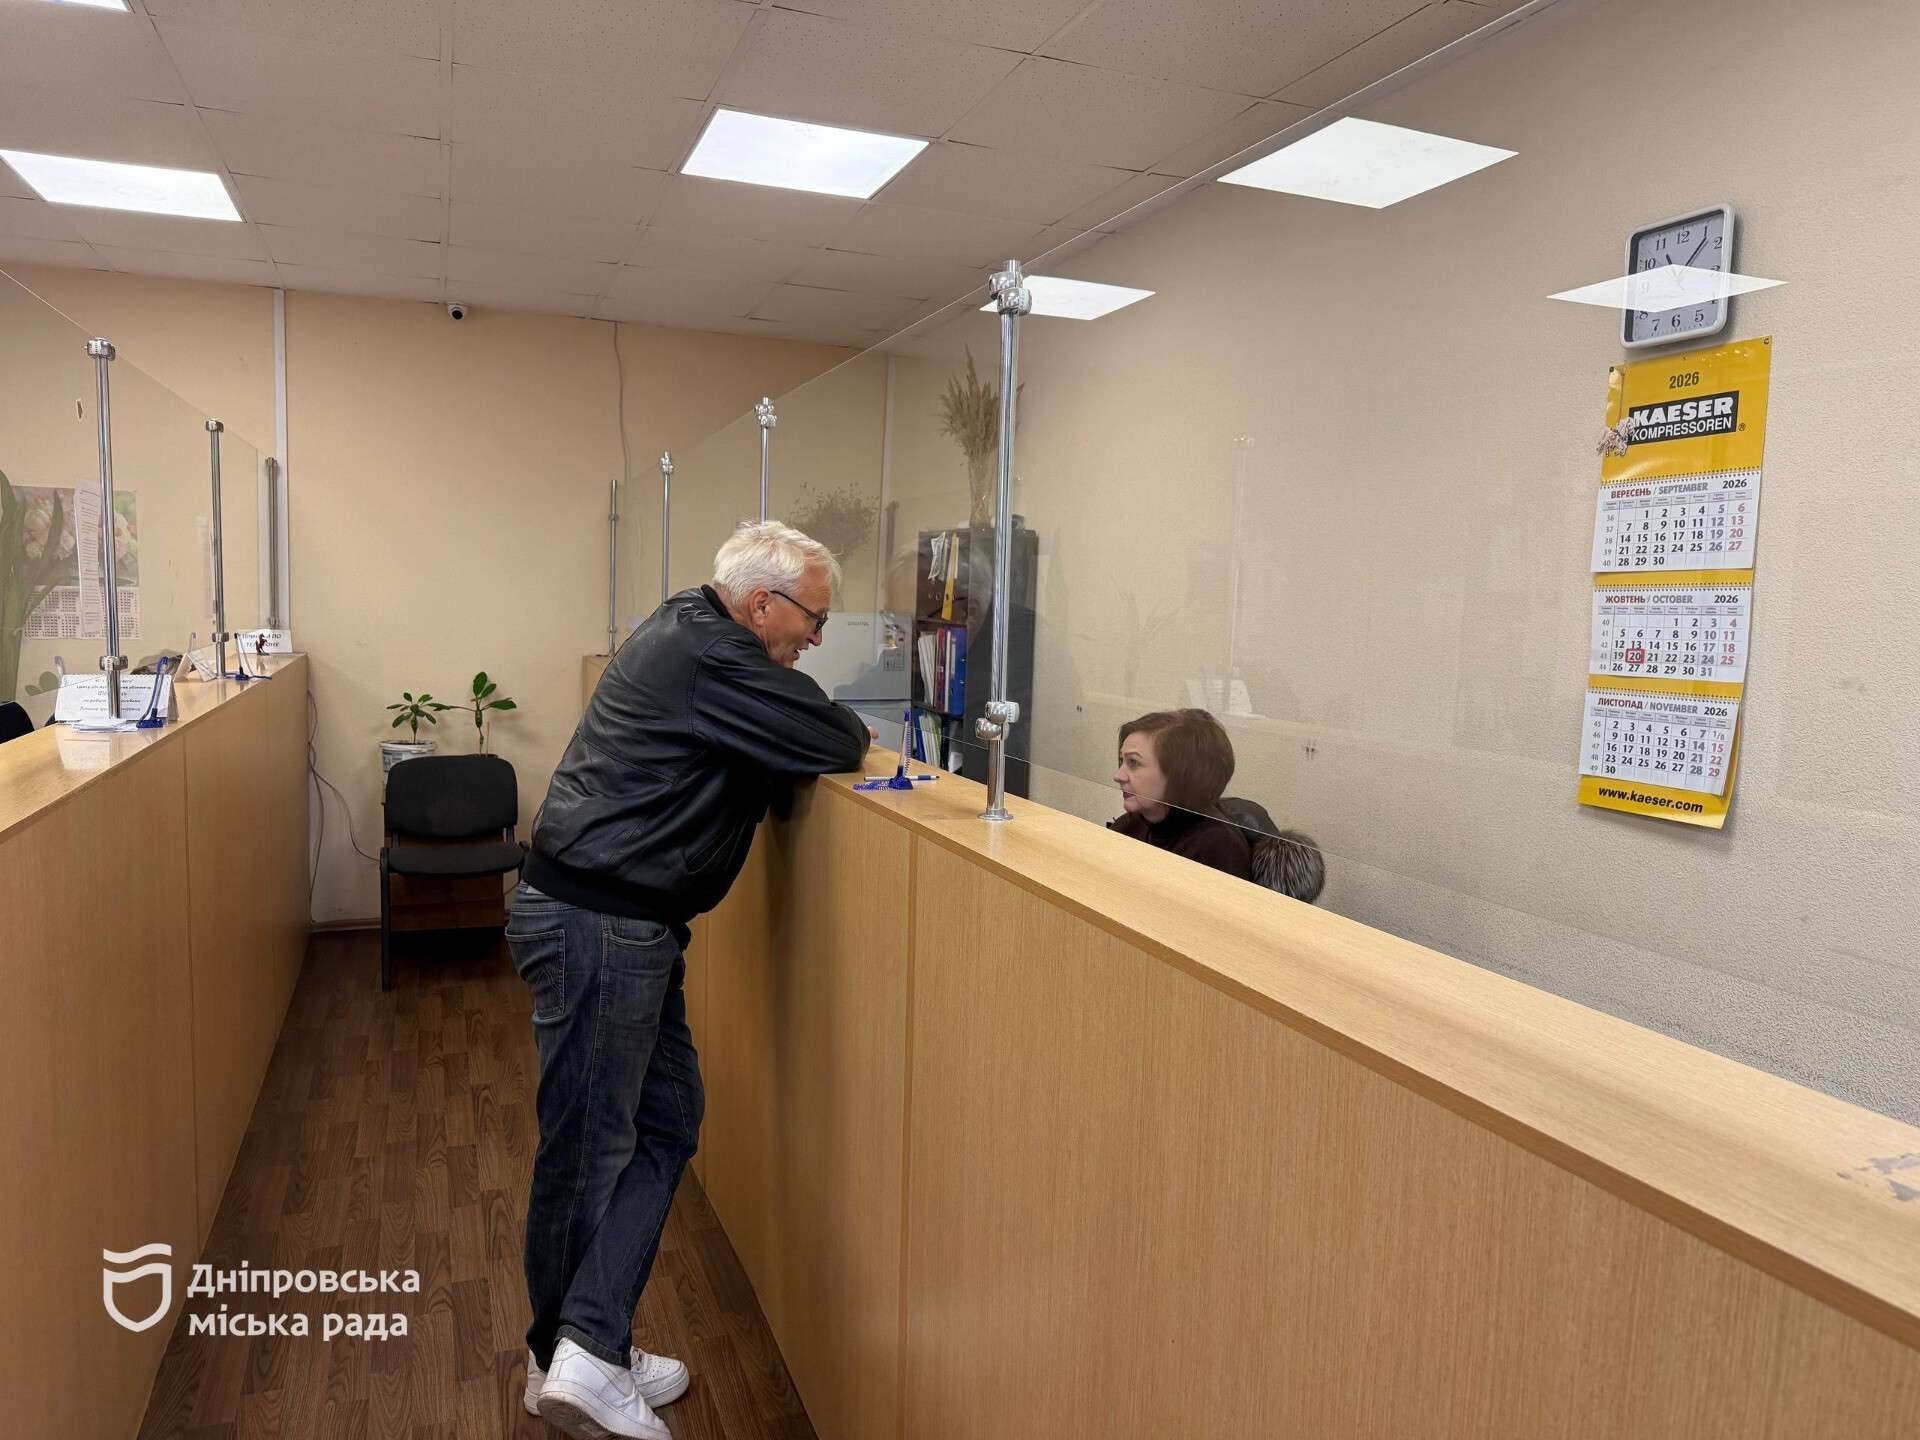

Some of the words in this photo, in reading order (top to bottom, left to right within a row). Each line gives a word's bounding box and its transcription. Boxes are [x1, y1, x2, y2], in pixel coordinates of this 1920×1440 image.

[1677, 231, 1690, 244] 12
[1714, 237, 1722, 249] 2
[1656, 239, 1665, 250] 11
[1645, 258, 1656, 270] 10
[1672, 314, 1680, 328] 6
[1695, 310, 1704, 322] 5
[1652, 319, 1660, 331] 7
[1669, 372, 1699, 389] 2026
[1632, 396, 1734, 426] KAESER
[1632, 417, 1731, 441] KOMPRESSOREN
[1611, 487, 1650, 498] ВЕРЕСЕНЬ
[1659, 483, 1708, 494] SEPTEMBER
[1723, 479, 1747, 488] 2026
[1662, 509, 1667, 517] 2
[1699, 506, 1705, 514] 4
[1719, 505, 1724, 513] 5
[1738, 503, 1745, 512] 6
[1674, 519, 1685, 528] 10
[1693, 519, 1703, 527] 11
[1712, 517, 1724, 526] 12
[1732, 516, 1743, 525] 13
[1673, 532, 1684, 540] 17
[1692, 531, 1703, 539] 18
[1711, 529, 1723, 538] 19
[1730, 528, 1743, 537] 20
[1653, 545, 1664, 553] 23
[1672, 544, 1683, 552] 24
[1690, 543, 1702, 552] 25
[1709, 542, 1722, 551] 26
[1728, 541, 1742, 550] 27
[1652, 595, 1693, 603] OCTOBER
[1714, 595, 1738, 603] 2026
[1730, 619, 1736, 627] 4
[1705, 631, 1716, 639] 10
[1724, 631, 1735, 640] 11
[1631, 641, 1641, 649] 13
[1704, 643, 1715, 651] 17
[1723, 644, 1735, 652] 18
[1665, 654, 1677, 662] 22
[1702, 656, 1714, 664] 24
[1721, 656, 1734, 665] 25
[1664, 666, 1676, 674] 29
[1682, 667, 1694, 675] 30
[1701, 667, 1712, 676] 31
[1598, 698, 1643, 709] ЛИСТОПАД
[1650, 704, 1698, 713] NOVEMBER
[1704, 707, 1727, 716] 2026
[1700, 730, 1706, 738] 7
[1658, 738, 1668, 746] 12
[1675, 740, 1686, 748] 13
[1693, 741, 1705, 750] 14
[1712, 743, 1723, 752] 15
[1607, 743, 1617, 751] 16
[1673, 752, 1685, 760] 20
[1692, 754, 1703, 762] 21
[1711, 756, 1722, 764] 22
[1655, 761, 1666, 769] 26
[1690, 766, 1702, 775] 28
[1708, 768, 1719, 776] 29
[1598, 787, 1703, 812] www.kaeser.com
